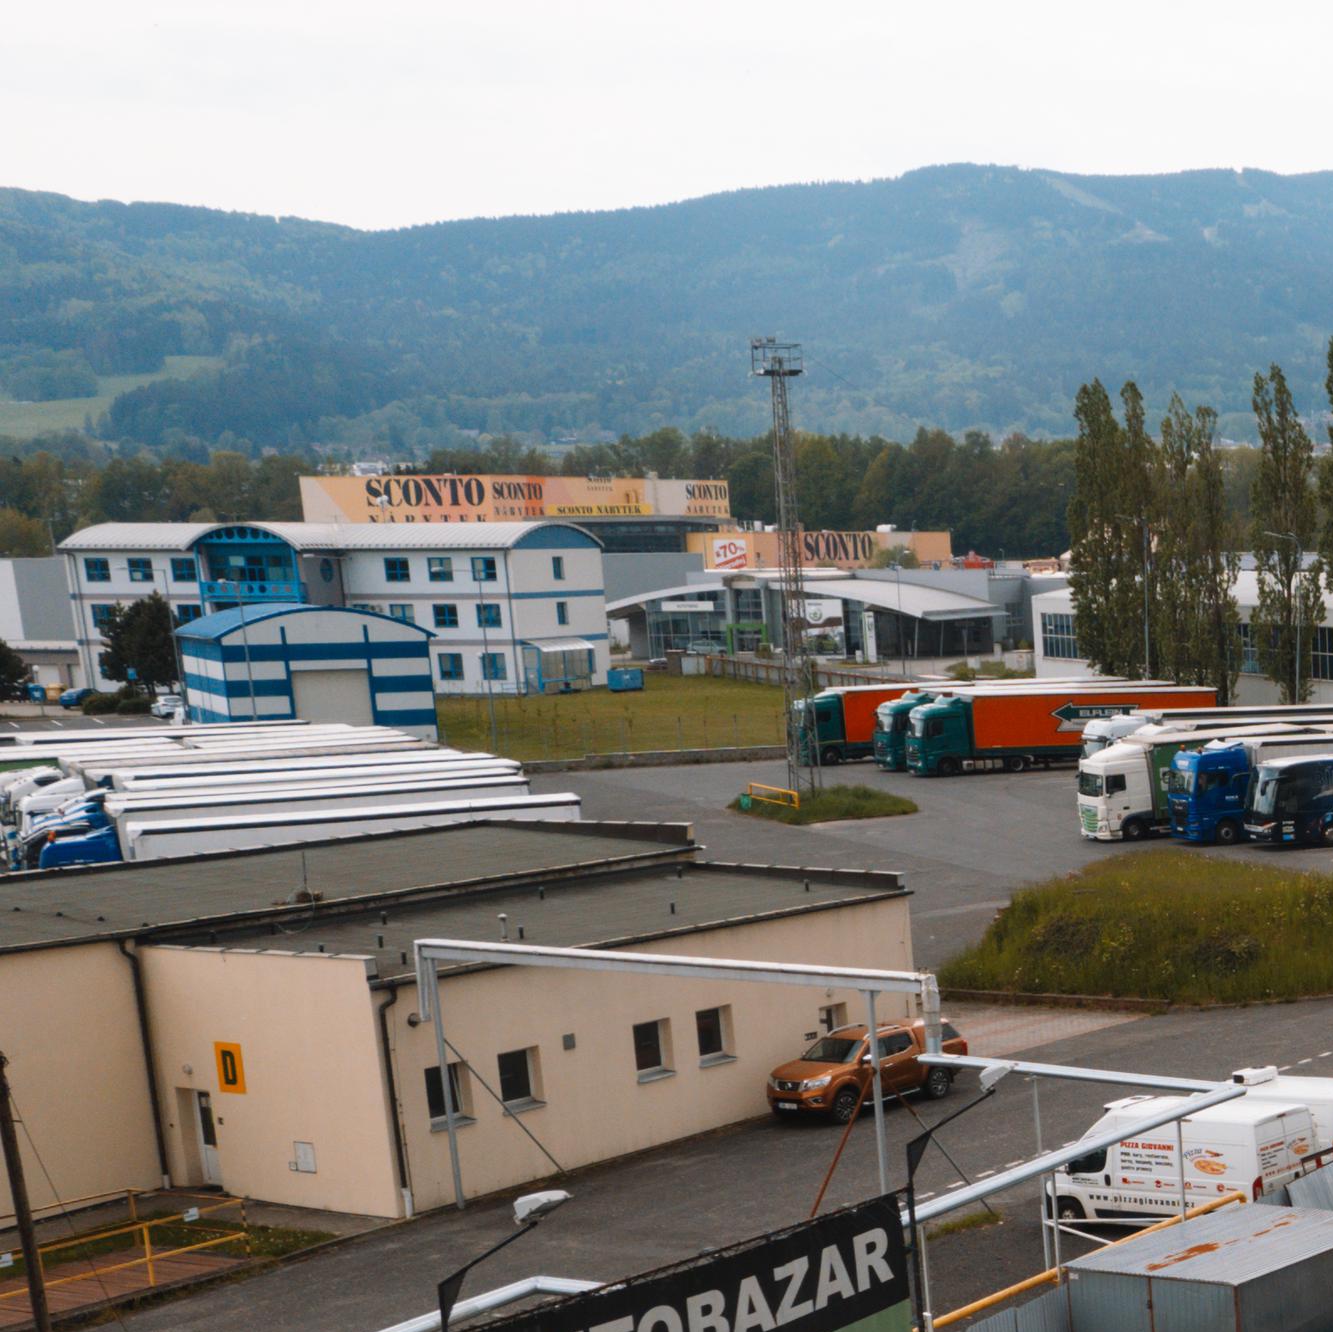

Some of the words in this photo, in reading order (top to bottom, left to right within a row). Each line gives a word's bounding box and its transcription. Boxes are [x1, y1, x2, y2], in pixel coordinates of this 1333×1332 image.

[365, 477, 485, 507] SCONTO
[492, 482, 544, 500] SCONTO
[686, 483, 727, 500] SCONTO
[557, 506, 592, 515] SCONTO
[804, 533, 873, 561] SCONTO
[221, 1050, 237, 1085] D
[1119, 1140, 1139, 1149] PIZZA
[1141, 1143, 1174, 1152] GIOVANNI
